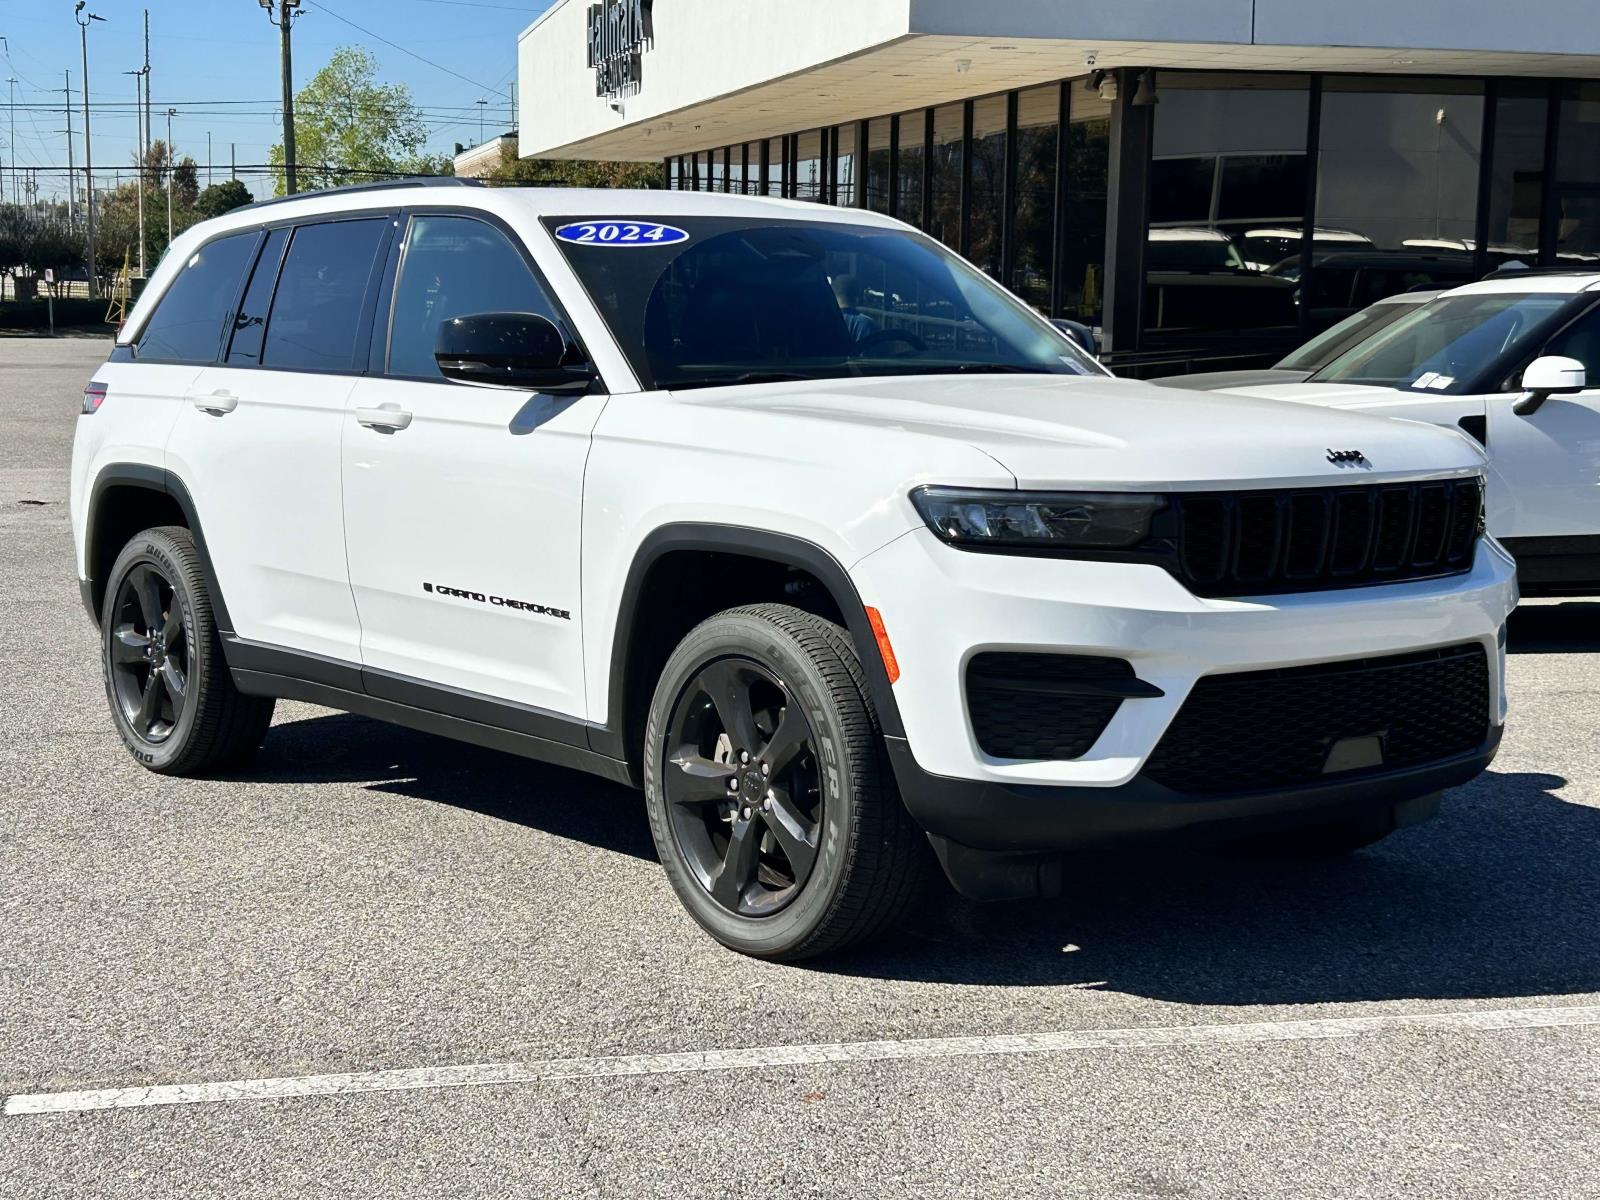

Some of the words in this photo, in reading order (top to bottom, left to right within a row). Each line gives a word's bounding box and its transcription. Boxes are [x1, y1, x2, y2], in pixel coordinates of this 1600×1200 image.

[576, 225, 665, 241] 2024
[1326, 448, 1364, 465] Jeep
[436, 585, 486, 603] GRAND
[489, 595, 571, 621] CHEROKEE
